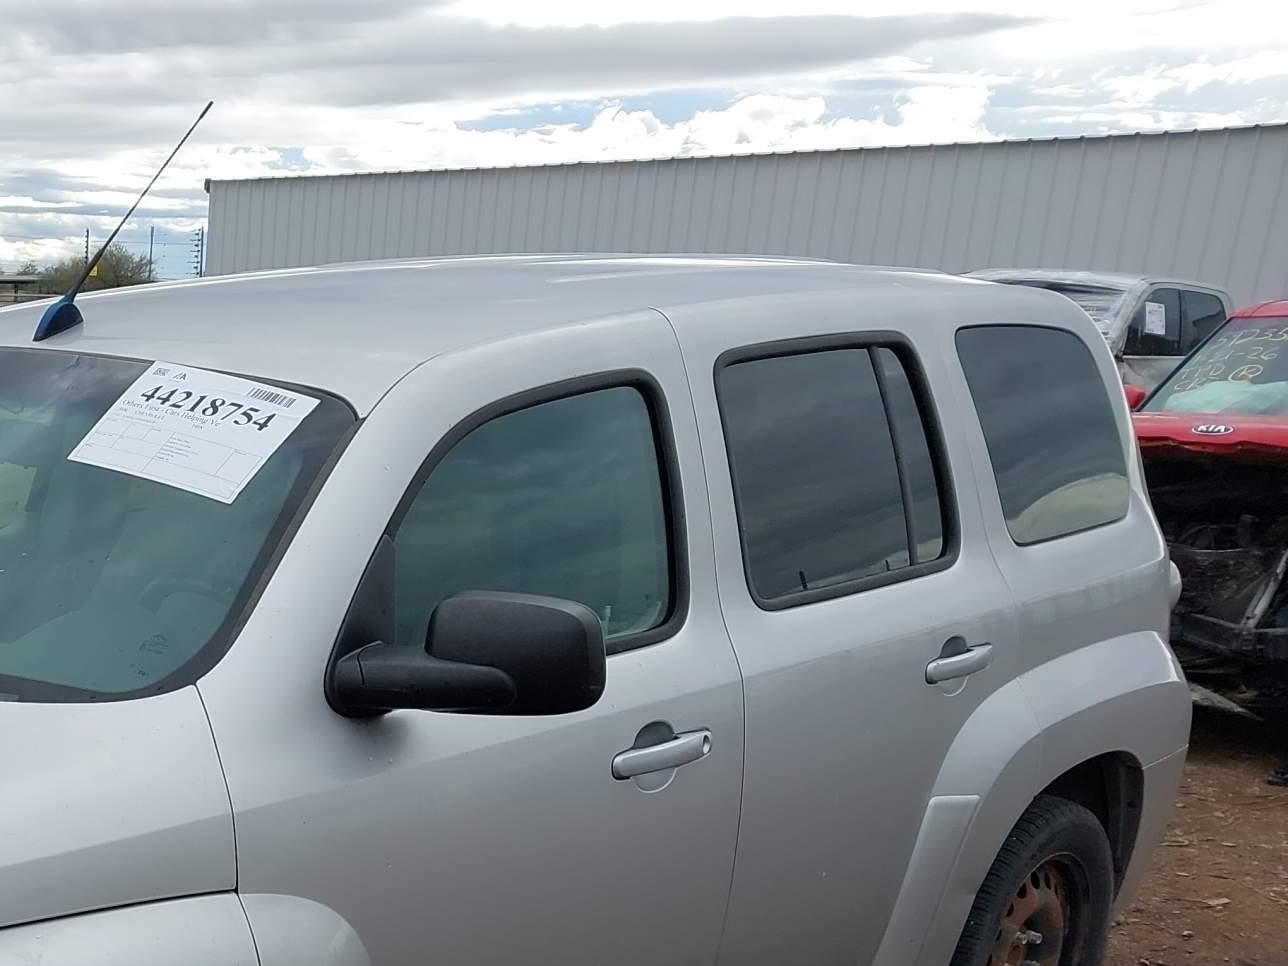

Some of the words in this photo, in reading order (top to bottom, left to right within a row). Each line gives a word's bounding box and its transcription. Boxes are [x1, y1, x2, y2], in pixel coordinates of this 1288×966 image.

[122, 400, 143, 409] Others
[181, 412, 209, 425] Helping
[141, 385, 277, 431] 44218754
[1197, 424, 1226, 433] KIA
